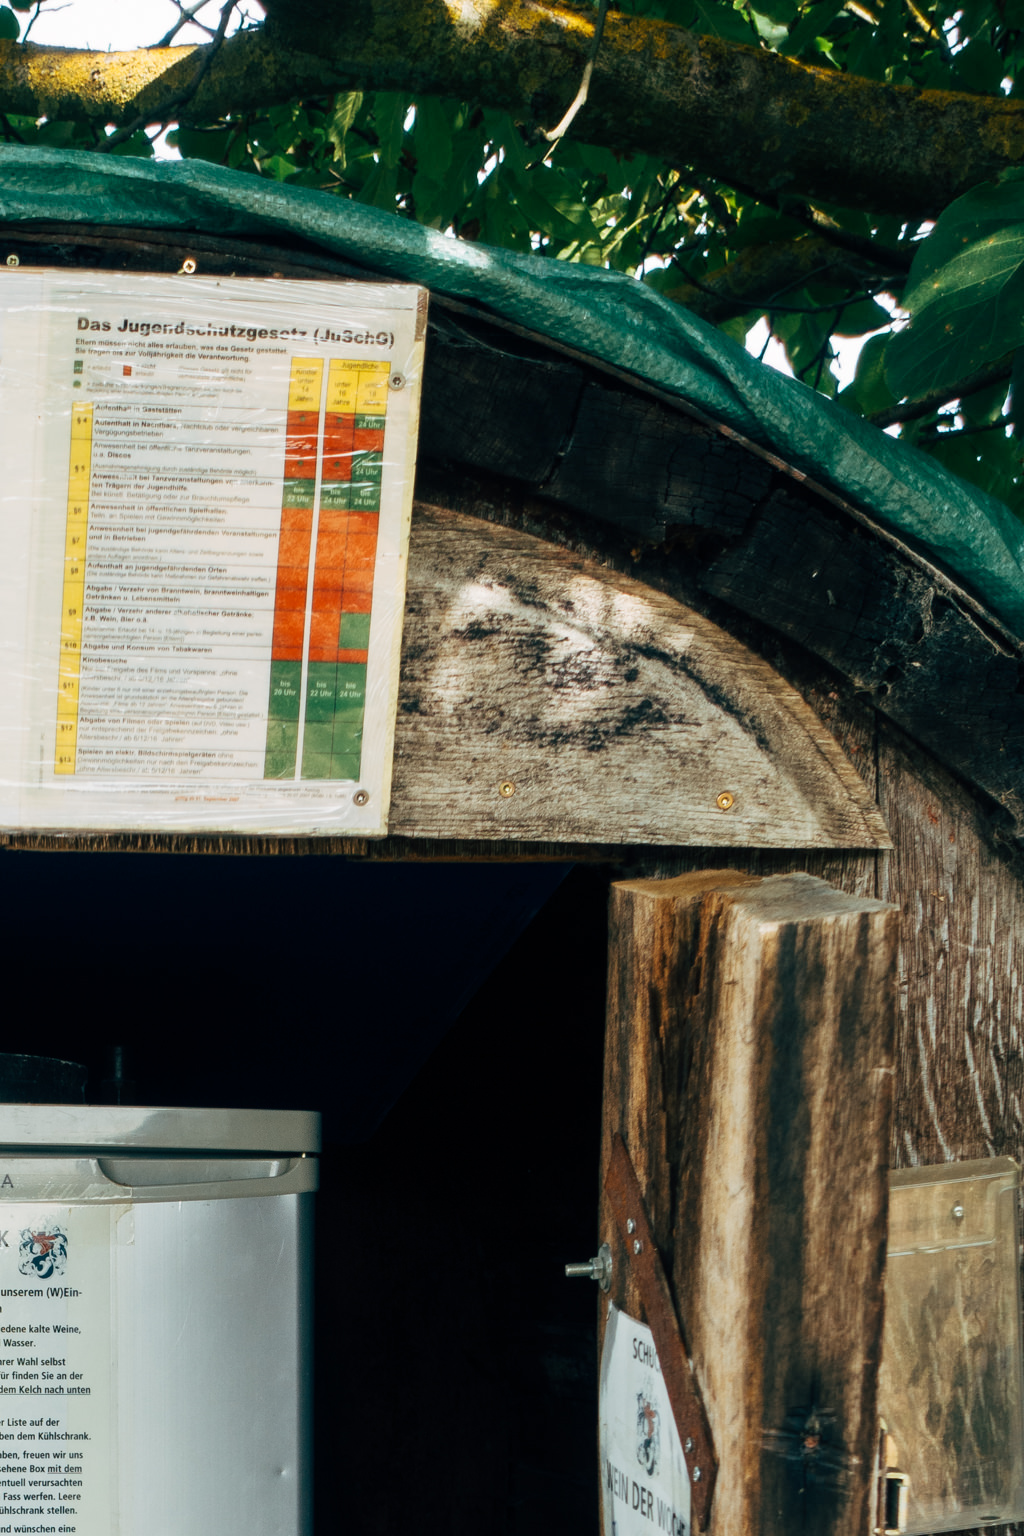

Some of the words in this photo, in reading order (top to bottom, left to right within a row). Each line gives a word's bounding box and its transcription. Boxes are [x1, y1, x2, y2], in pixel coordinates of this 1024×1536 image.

[0, 1288, 43, 1296] unserem
[46, 1286, 82, 1299] (W)Ein-
[28, 1324, 50, 1333] kalte
[52, 1324, 81, 1334] Weine,
[2, 1338, 36, 1347] Wasser.
[632, 1337, 662, 1373] SCHUC
[16, 1356, 38, 1366] Wahl
[40, 1356, 65, 1366] selbst
[6, 1417, 27, 1426] Liste
[29, 1417, 43, 1426] auf
[45, 1417, 60, 1426] der
[16, 1431, 35, 1440] dem
[37, 1431, 91, 1440] Kühlschrank.
[607, 1459, 630, 1504] WEIN
[632, 1480, 654, 1522] DER
